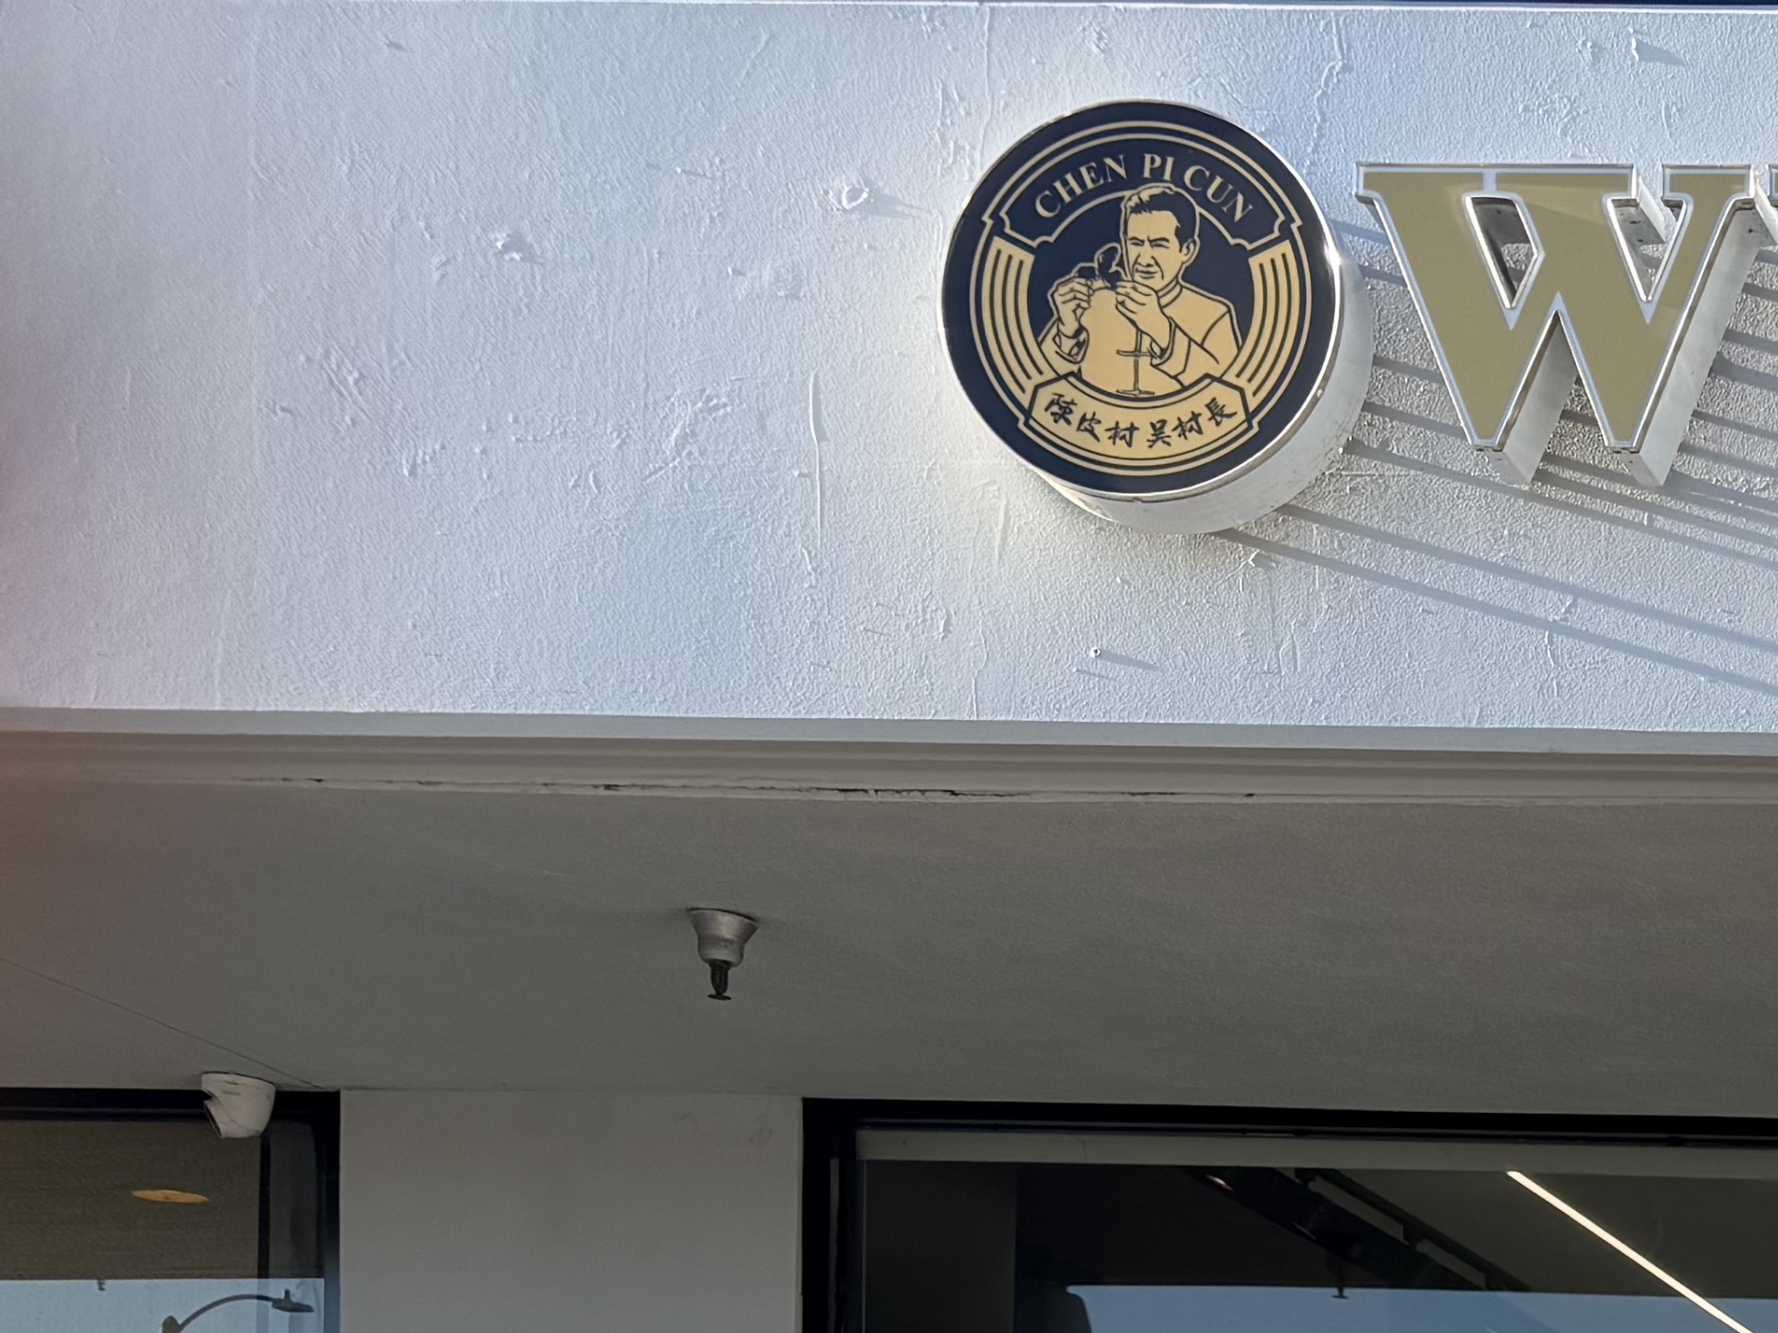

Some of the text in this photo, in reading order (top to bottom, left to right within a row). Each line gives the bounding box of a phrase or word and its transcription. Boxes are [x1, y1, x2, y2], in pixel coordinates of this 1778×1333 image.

[1034, 153, 1253, 224] CHEN PI CUN
